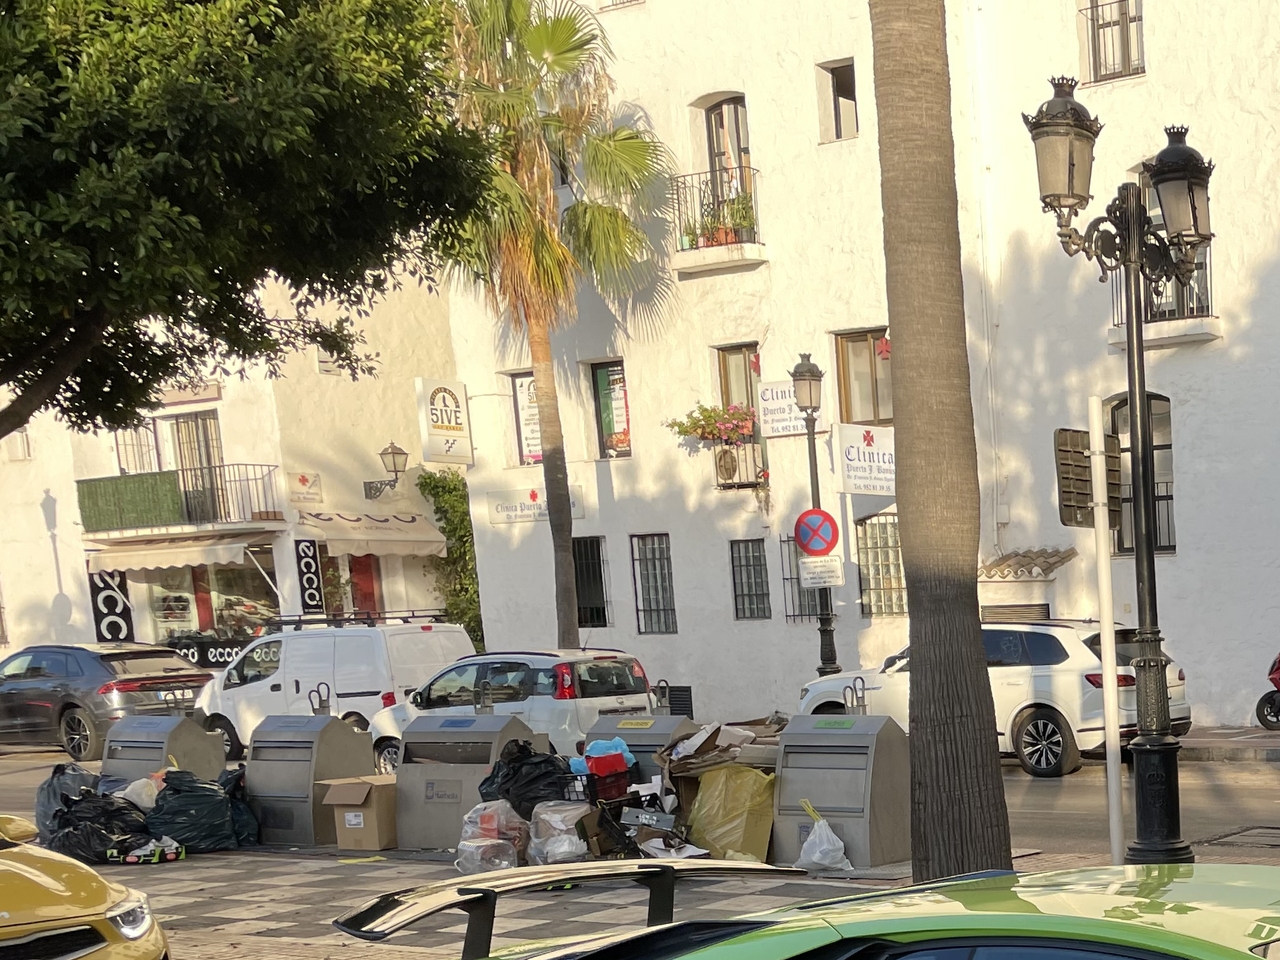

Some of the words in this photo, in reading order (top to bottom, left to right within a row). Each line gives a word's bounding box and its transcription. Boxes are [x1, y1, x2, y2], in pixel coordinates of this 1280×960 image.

[761, 386, 795, 402] Clini
[430, 407, 463, 426] 5IVE
[762, 405, 786, 418] Puerto
[298, 541, 320, 606] ecco
